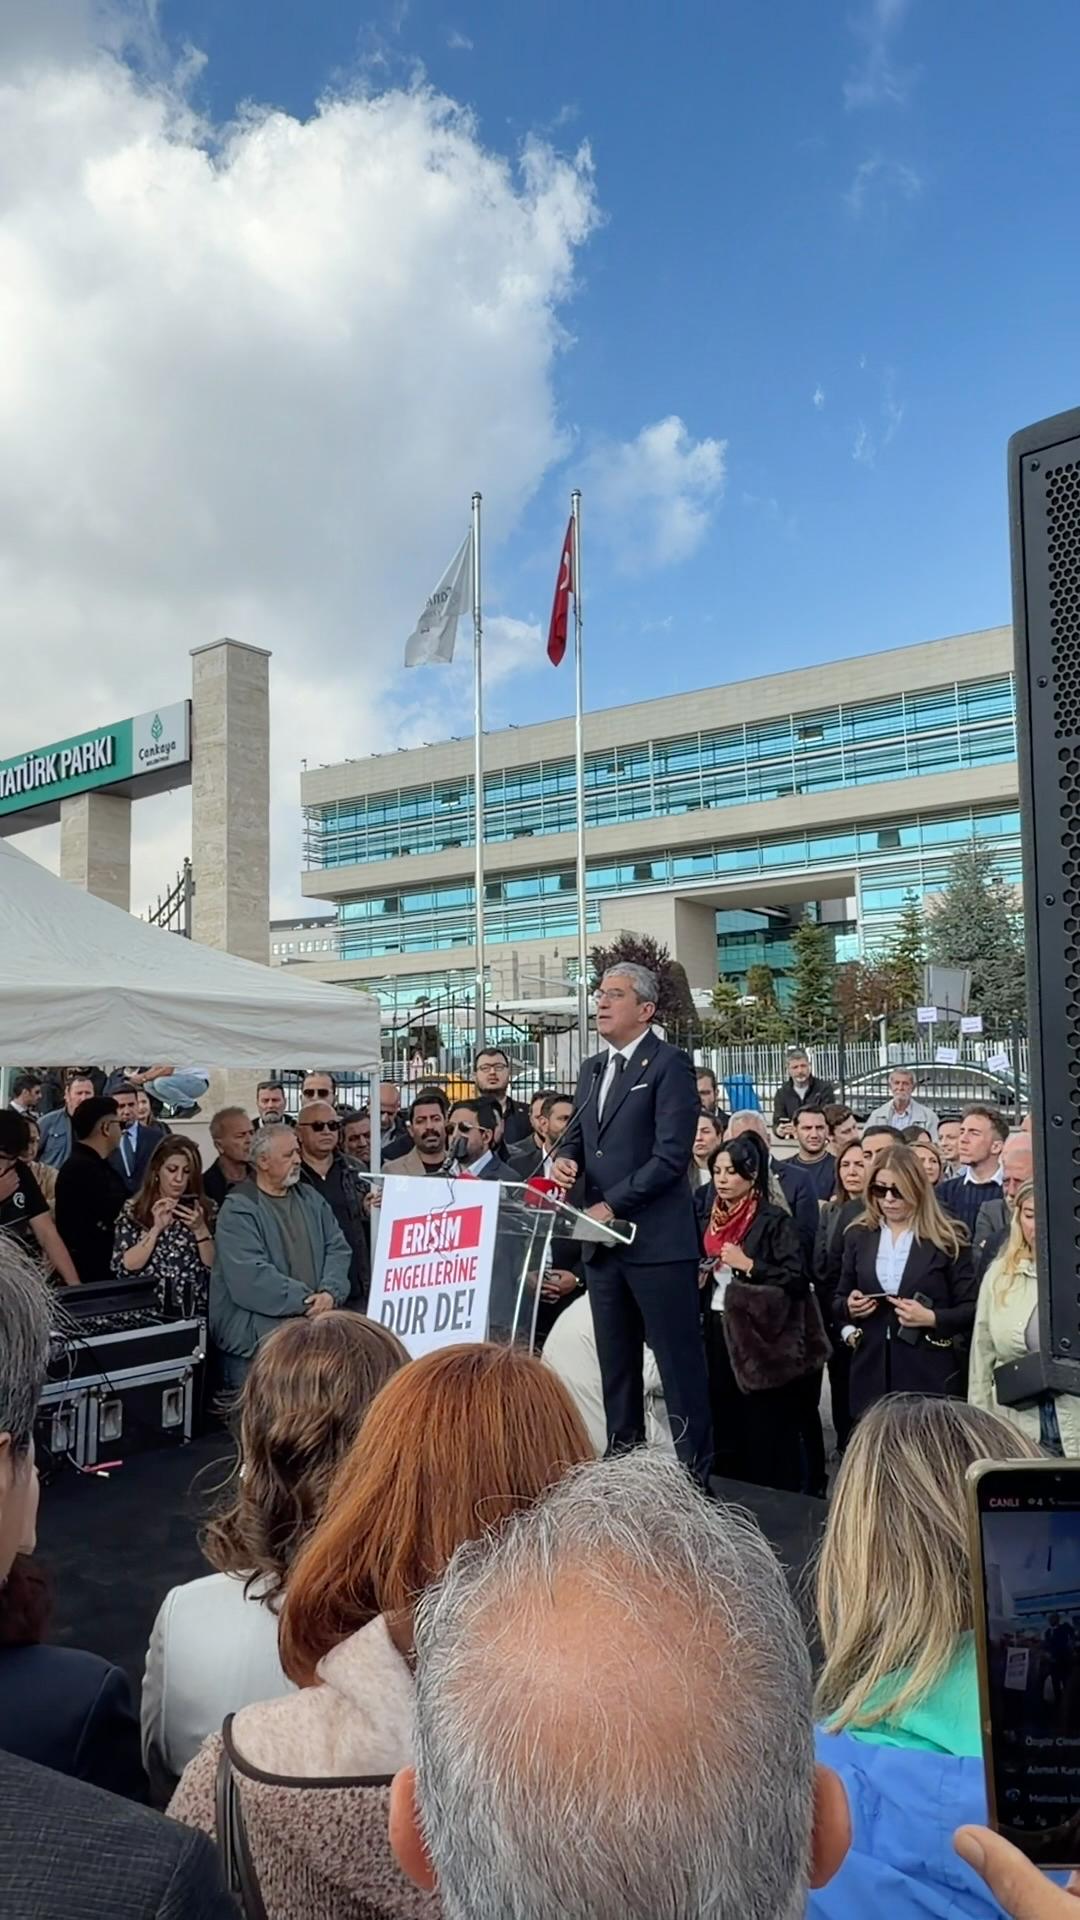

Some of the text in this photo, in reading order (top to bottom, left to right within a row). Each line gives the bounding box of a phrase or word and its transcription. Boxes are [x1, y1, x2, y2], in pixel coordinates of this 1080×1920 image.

[60, 735, 113, 779] PARKI
[401, 1214, 461, 1255] ERİŞİM
[384, 1254, 478, 1293] ENGELLERİNE
[380, 1288, 476, 1337] DUR DE!
[989, 1497, 1020, 1508] CANLI
